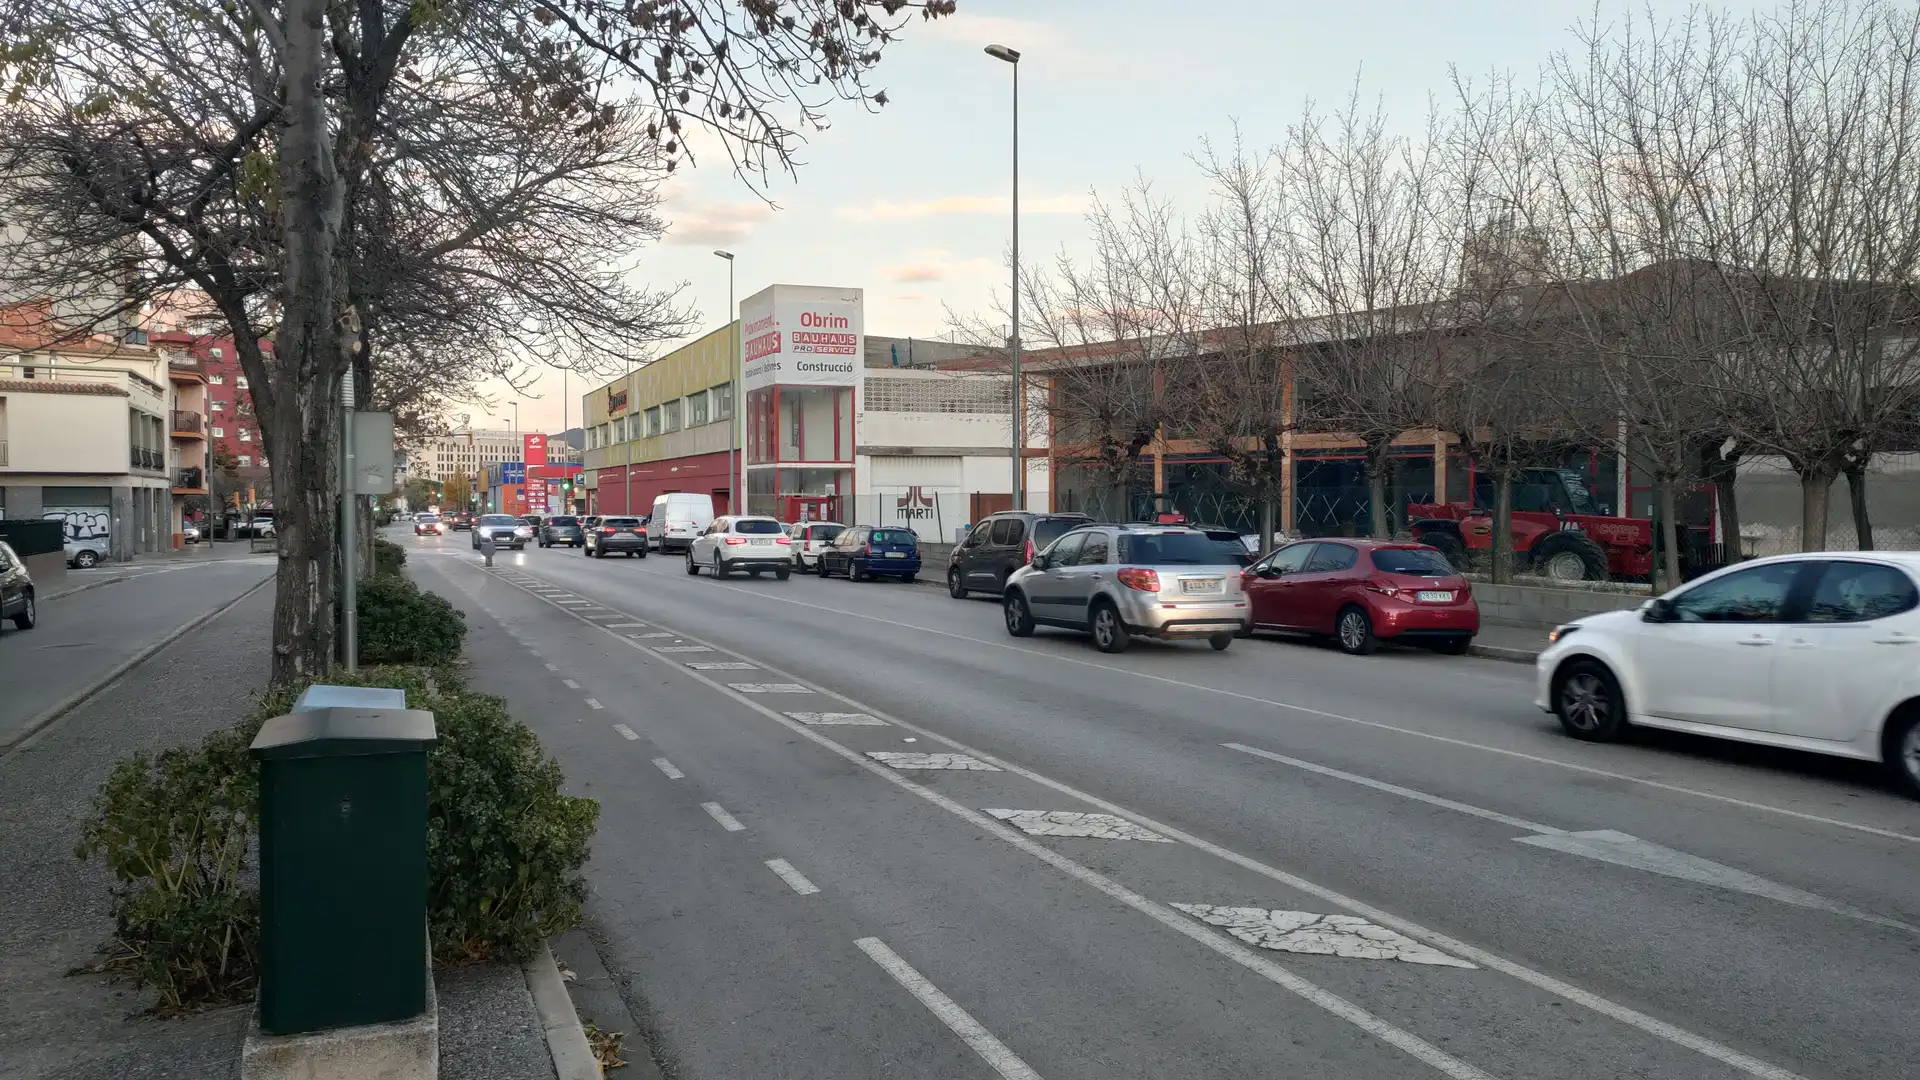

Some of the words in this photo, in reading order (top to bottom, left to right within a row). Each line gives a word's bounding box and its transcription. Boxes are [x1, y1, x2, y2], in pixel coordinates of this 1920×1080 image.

[800, 311, 848, 329] Obrim
[793, 333, 856, 345] BAUHAUS
[745, 332, 779, 360] BAUHAUS
[793, 345, 814, 353] PRO
[816, 346, 855, 354] SERVICE
[796, 361, 853, 373] Construcció
[897, 508, 934, 520] MARTI
